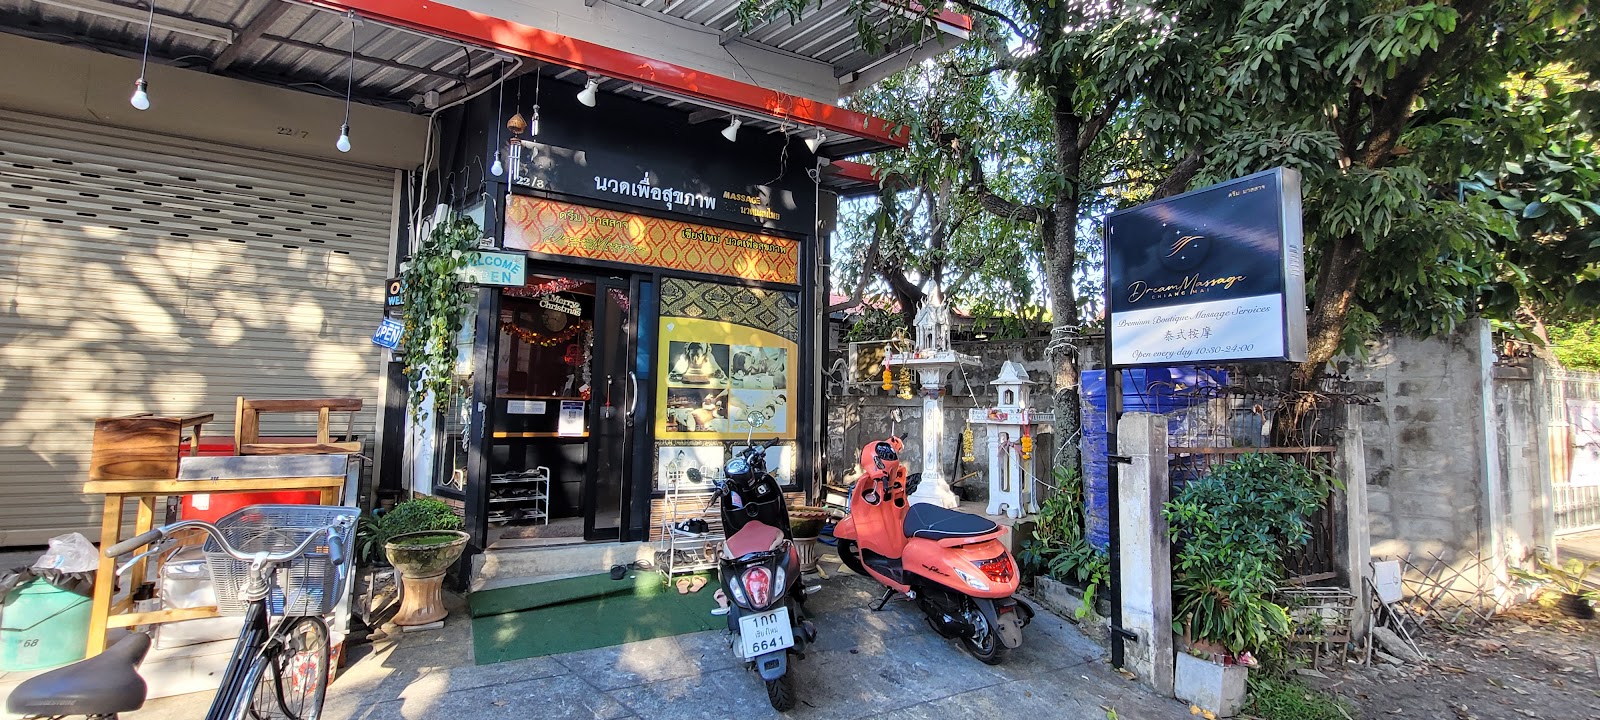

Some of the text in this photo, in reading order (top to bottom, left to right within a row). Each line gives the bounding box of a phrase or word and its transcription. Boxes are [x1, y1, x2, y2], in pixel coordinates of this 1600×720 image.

[594, 171, 716, 211] นวดเพื่อสุขภาพ
[723, 190, 761, 205] MASSAGE
[559, 209, 582, 222] ดรีม
[682, 228, 787, 254] เชียงใหม่ นวดเพื่อสุขภาพ
[461, 255, 521, 275] LCOME
[550, 294, 580, 308] Merry
[1151, 291, 1186, 300] CHIANG
[539, 300, 581, 317] Christmas
[1117, 305, 1271, 328] Premium Boutique Massage Services
[375, 325, 400, 343] OPEN
[1164, 326, 1213, 342] 泰式按摩
[1131, 349, 1151, 361] Open
[1152, 350, 1176, 359] every
[1176, 346, 1193, 357] day
[23, 638, 40, 648] 68
[752, 635, 784, 653] 6641
